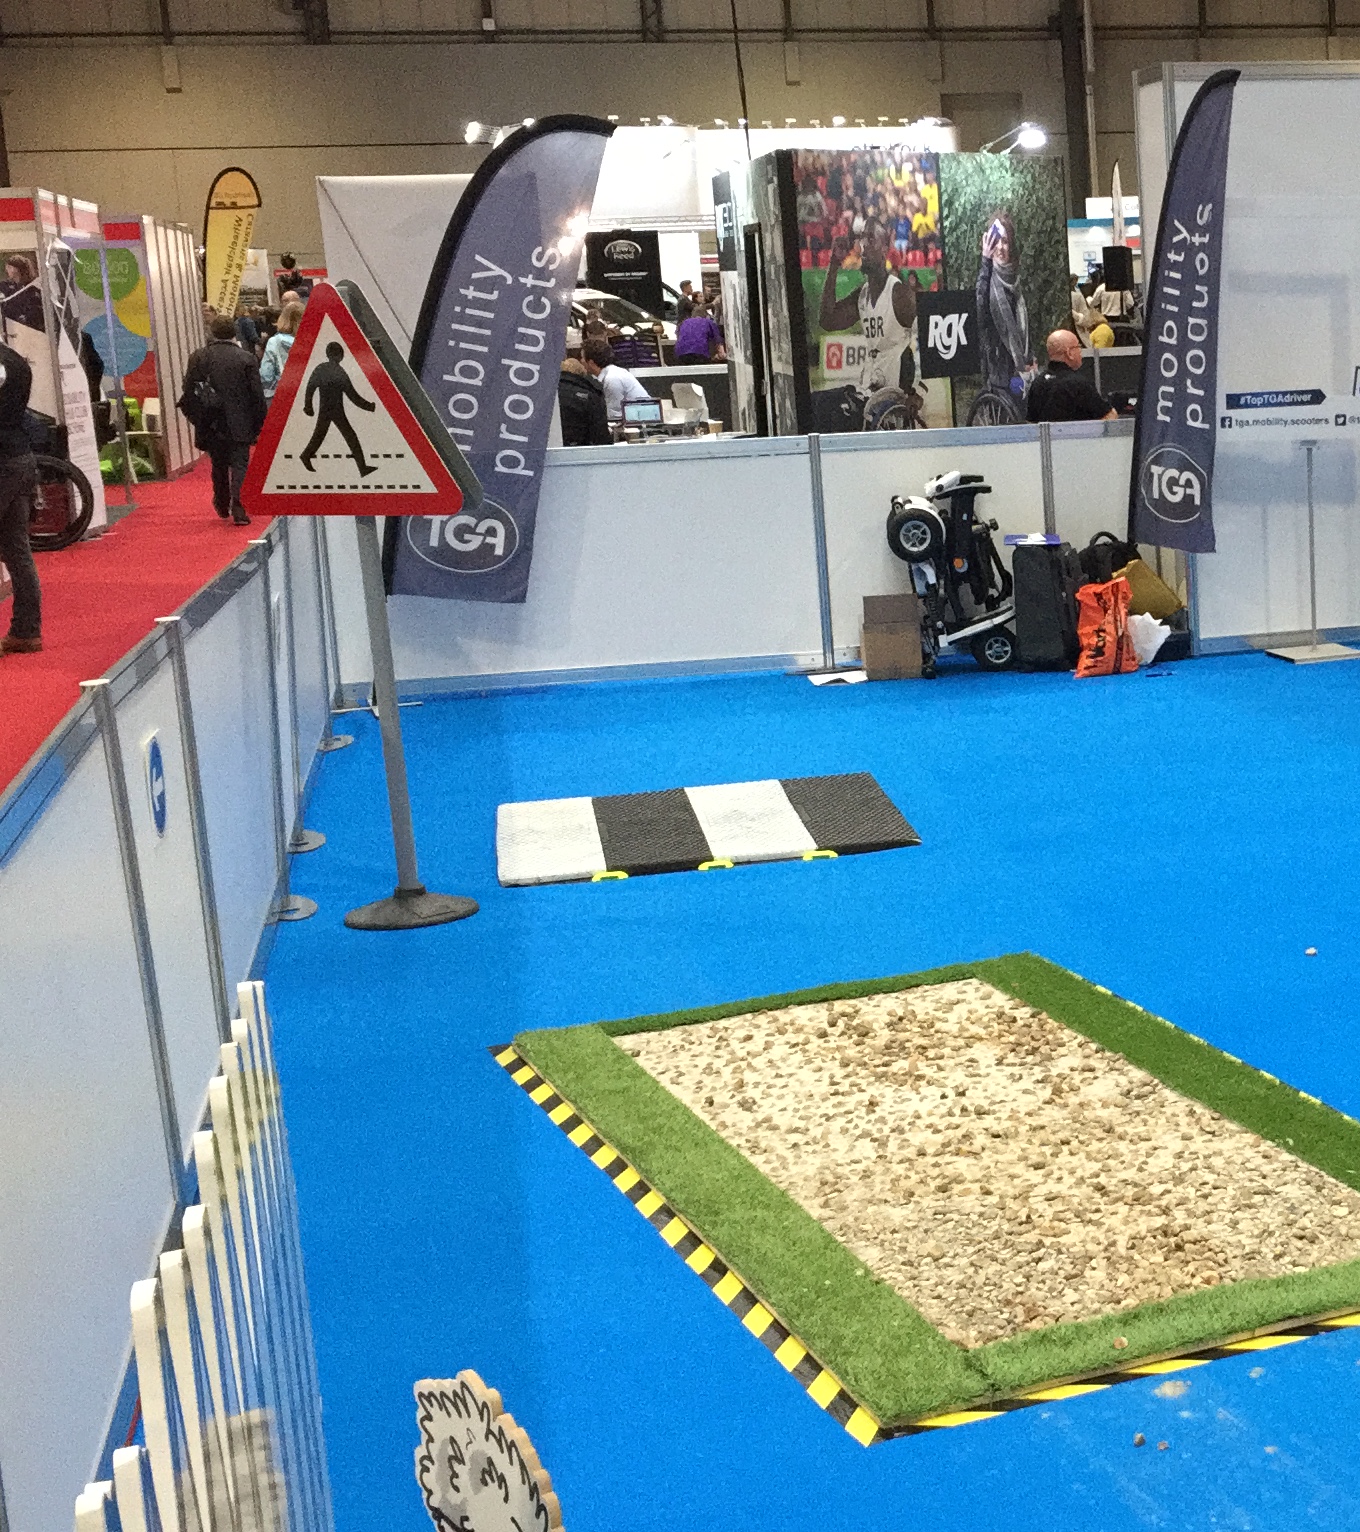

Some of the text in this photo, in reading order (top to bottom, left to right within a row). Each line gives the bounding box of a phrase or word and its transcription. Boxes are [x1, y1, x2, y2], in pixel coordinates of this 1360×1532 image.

[1156, 219, 1190, 422] mobility
[494, 246, 561, 476] products
[1239, 393, 1312, 407] #TopTGAdriver
[1150, 464, 1201, 506] TGA
[423, 515, 505, 556] TGA
